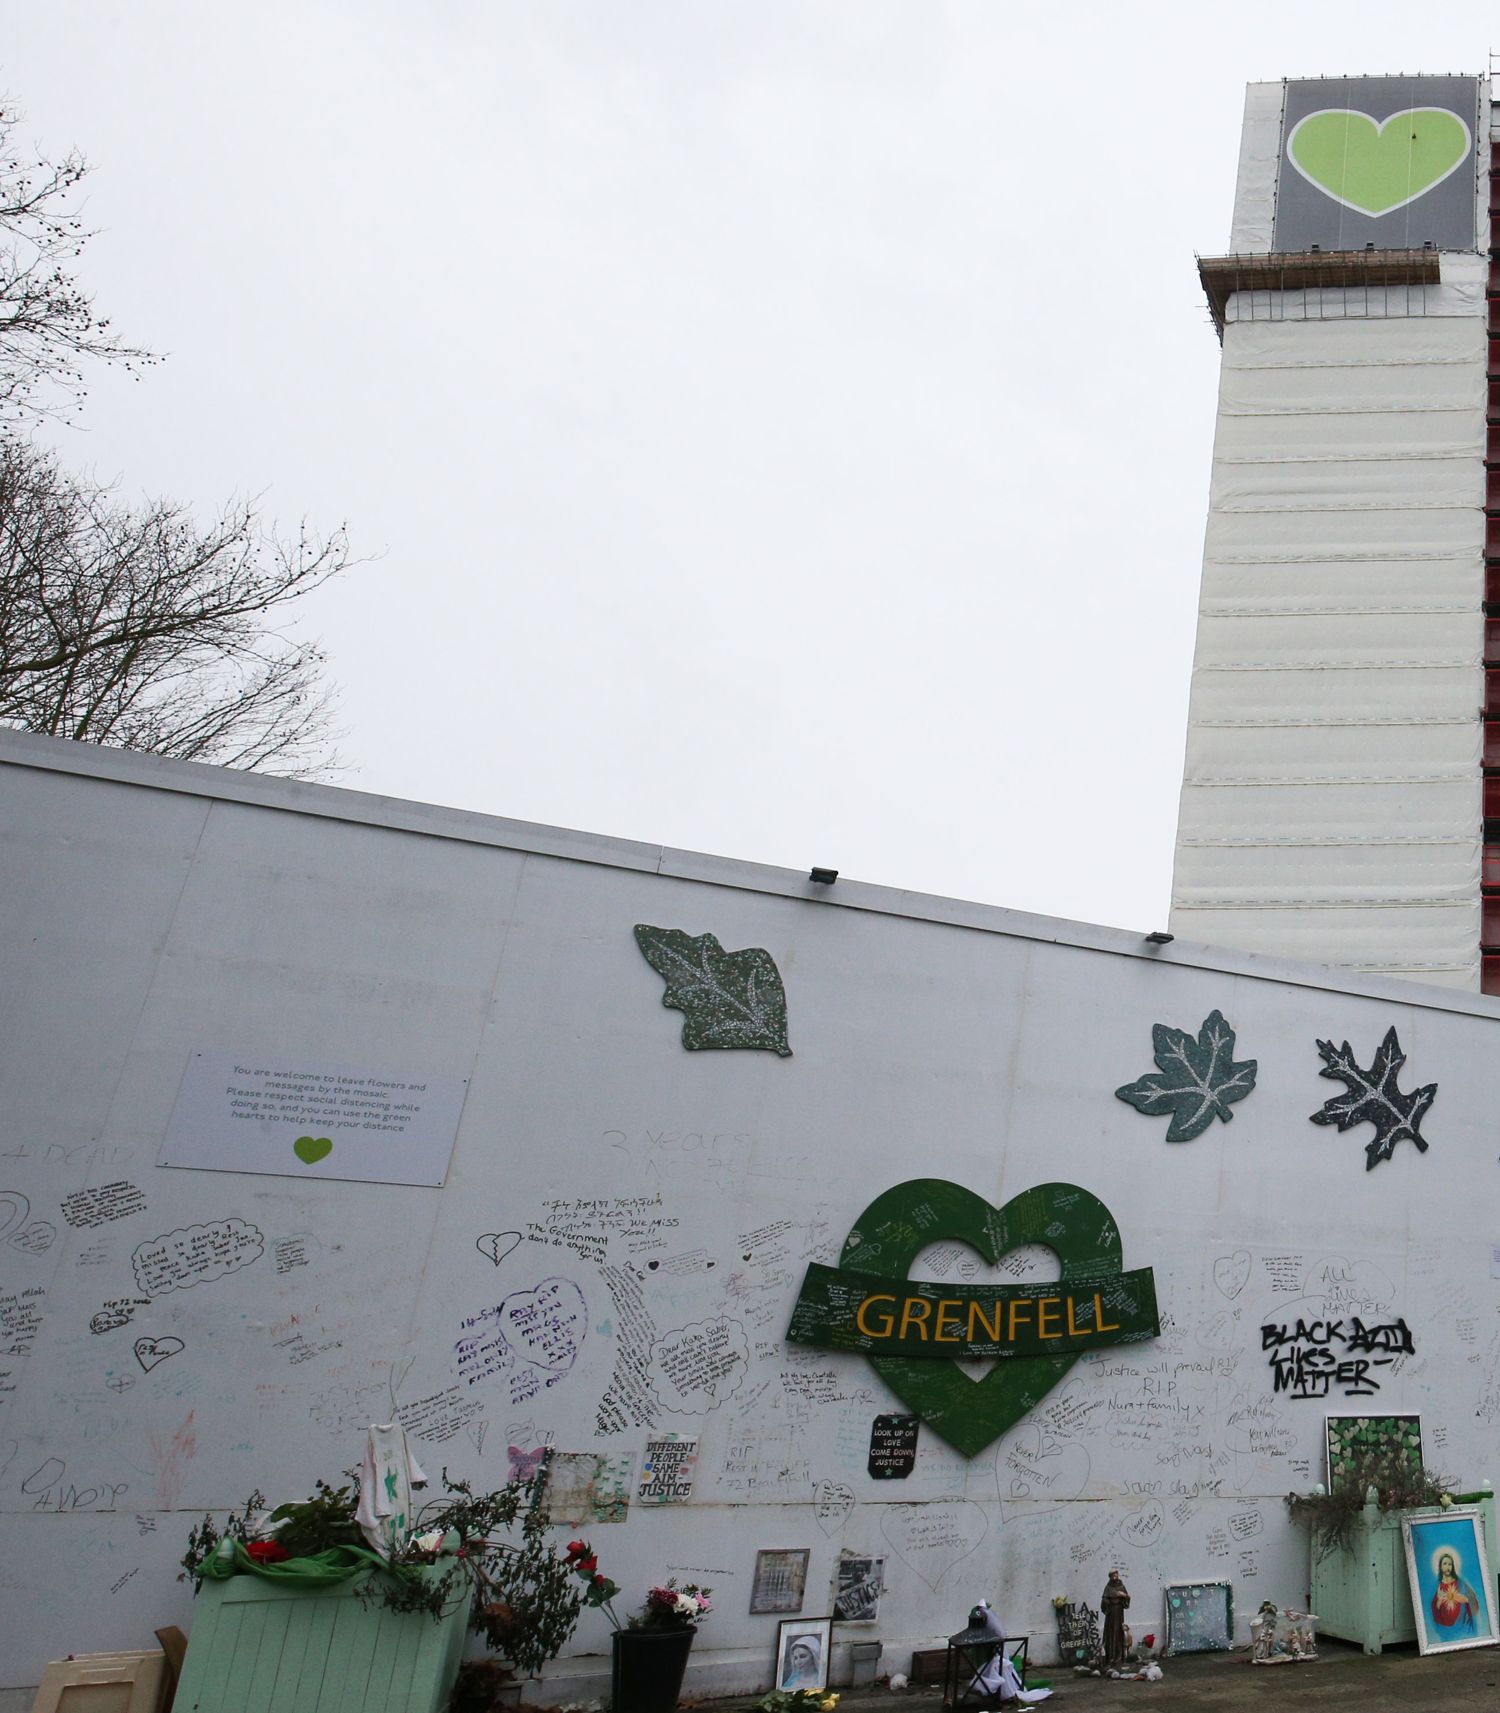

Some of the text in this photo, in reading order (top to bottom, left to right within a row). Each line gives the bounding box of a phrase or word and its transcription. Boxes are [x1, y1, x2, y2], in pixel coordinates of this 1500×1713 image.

[234, 1065, 426, 1091] You are welcome to leave flowers and
[265, 1081, 315, 1092] messages
[318, 1085, 330, 1094] by
[333, 1086, 351, 1094] the
[226, 1087, 420, 1112] Please respect social distancing while
[230, 1100, 259, 1111] doing
[262, 1103, 277, 1111] so,
[280, 1104, 299, 1112] and
[302, 1107, 320, 1115] you
[364, 1110, 380, 1119] the
[383, 1113, 411, 1122] green
[232, 1111, 405, 1132] hearts to help keep your distance
[526, 1223, 546, 1233] The
[549, 1225, 608, 1245] Government
[856, 1293, 1121, 1343] GRENFELL
[1261, 1319, 1346, 1350] BLACK
[1269, 1346, 1336, 1367] LIVES
[1089, 1358, 1140, 1378] Justice
[1146, 1362, 1168, 1374] will
[1273, 1360, 1381, 1398] MATTER
[874, 1429, 892, 1437] LOOK
[646, 1442, 697, 1452] DIFFERENT
[871, 1448, 891, 1456] COME
[651, 1463, 679, 1474] SAME
[875, 1458, 905, 1466] JUSTICE
[639, 1483, 692, 1497] JUSTICE
